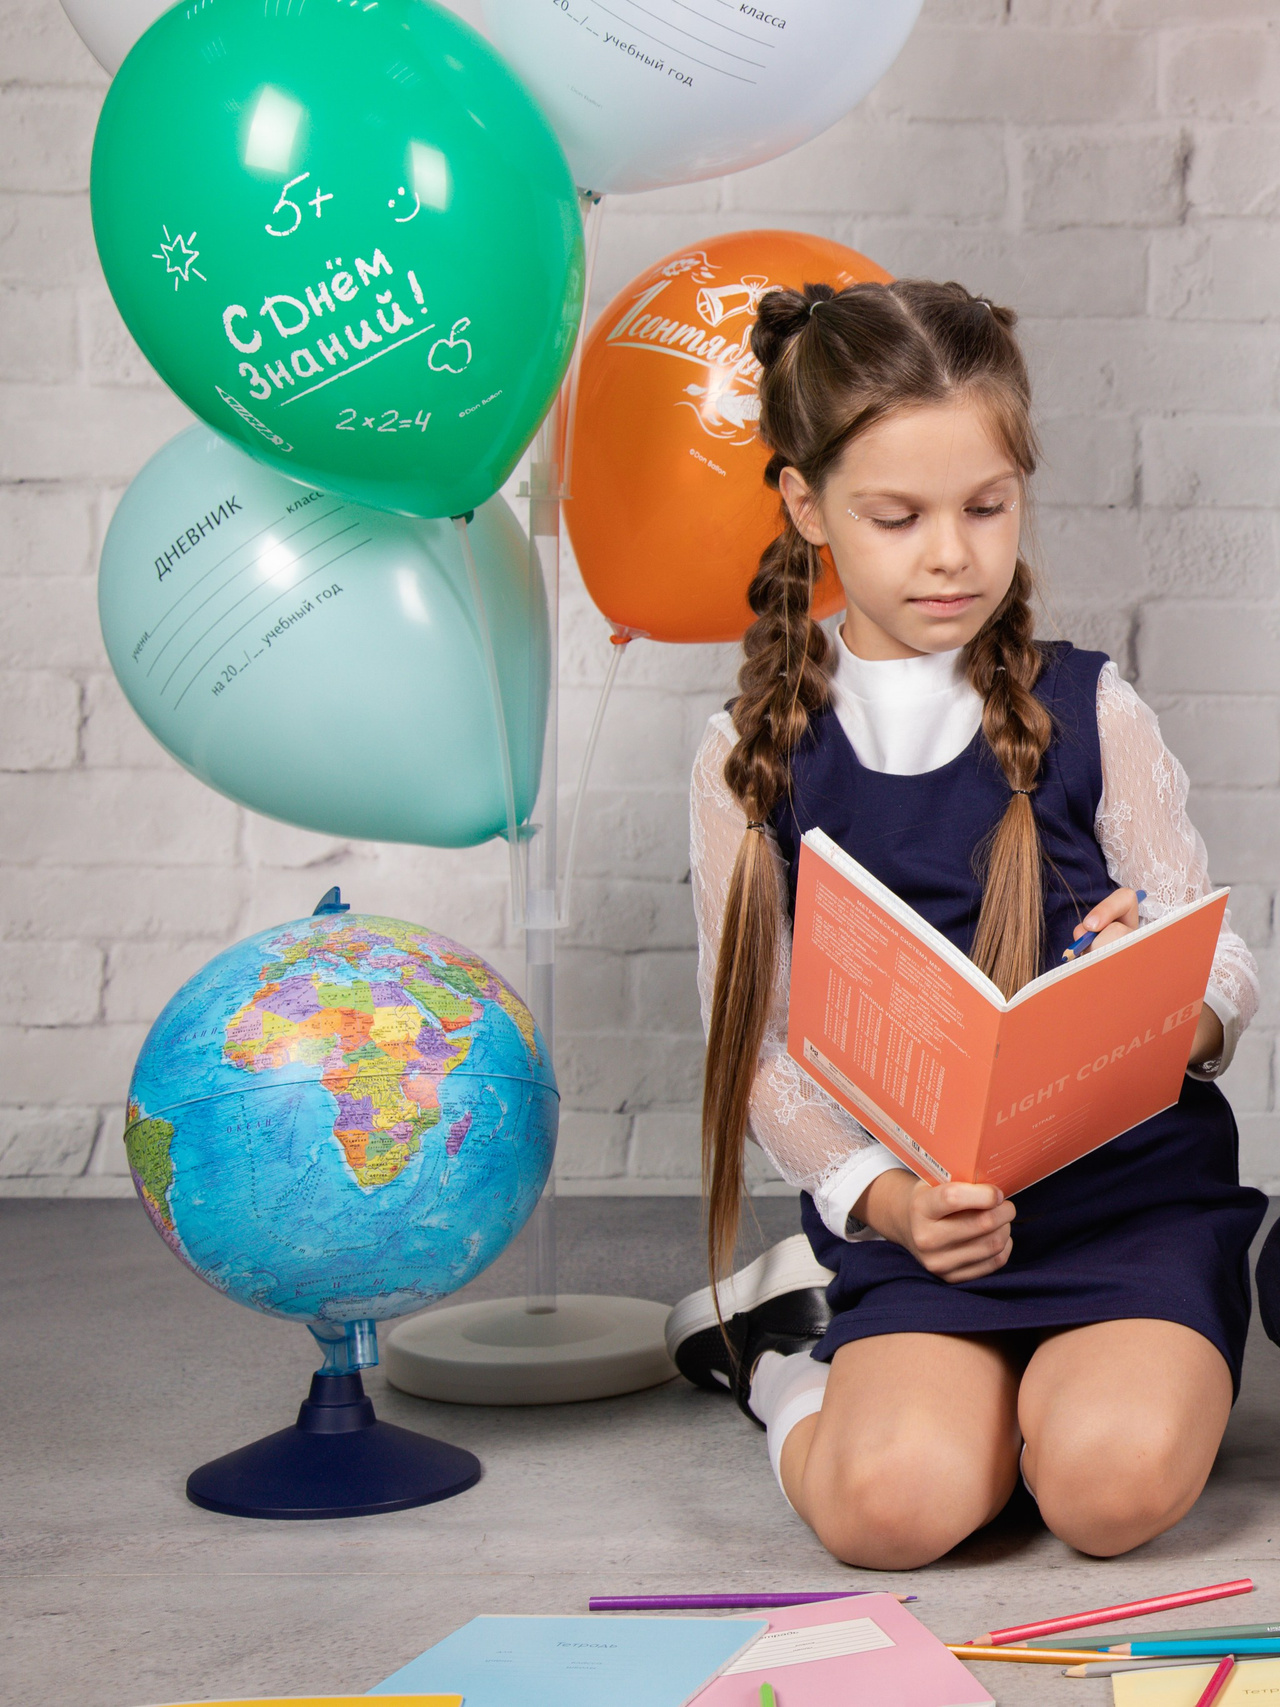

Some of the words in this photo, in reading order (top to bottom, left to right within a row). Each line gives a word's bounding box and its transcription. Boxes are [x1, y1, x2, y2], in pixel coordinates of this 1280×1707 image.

[739, 3, 787, 29] класса
[603, 32, 664, 71] учебный
[668, 68, 694, 87] год
[265, 172, 334, 236] 5+
[222, 304, 262, 353] С
[259, 248, 393, 338] Днём
[605, 279, 673, 342] 1
[154, 495, 243, 582] ДНЕВНИК
[131, 631, 151, 663] учени
[211, 680, 226, 696] на
[261, 599, 315, 647] учебный
[316, 583, 344, 605] год
[856, 899, 899, 937] МЕТРИЧЕСКАЯ
[900, 936, 928, 961] СИСТЕМА
[929, 960, 942, 973] МЕР
[859, 988, 884, 1012] ТАБЛИЦА
[885, 1011, 921, 1045] УМНОЖЕНИЯ
[995, 1074, 1071, 1126] LIGHT
[1076, 1028, 1157, 1081] CORAL
[1166, 1003, 1195, 1029] 18
